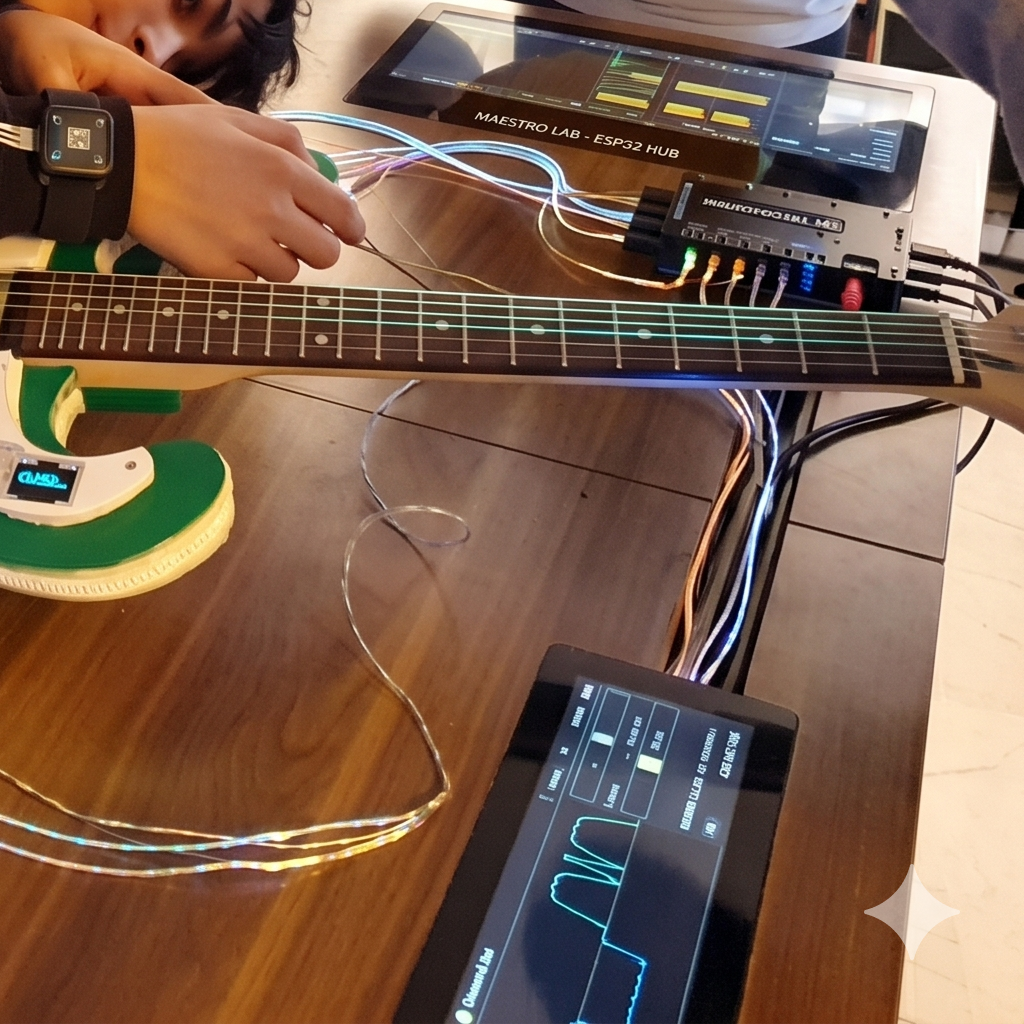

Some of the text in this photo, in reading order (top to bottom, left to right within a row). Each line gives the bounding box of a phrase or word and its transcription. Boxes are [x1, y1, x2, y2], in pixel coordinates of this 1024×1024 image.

[474, 111, 549, 133] MAESTRO
[551, 126, 581, 139] LAB
[593, 134, 643, 152] ESP32
[646, 144, 680, 159] HUB
